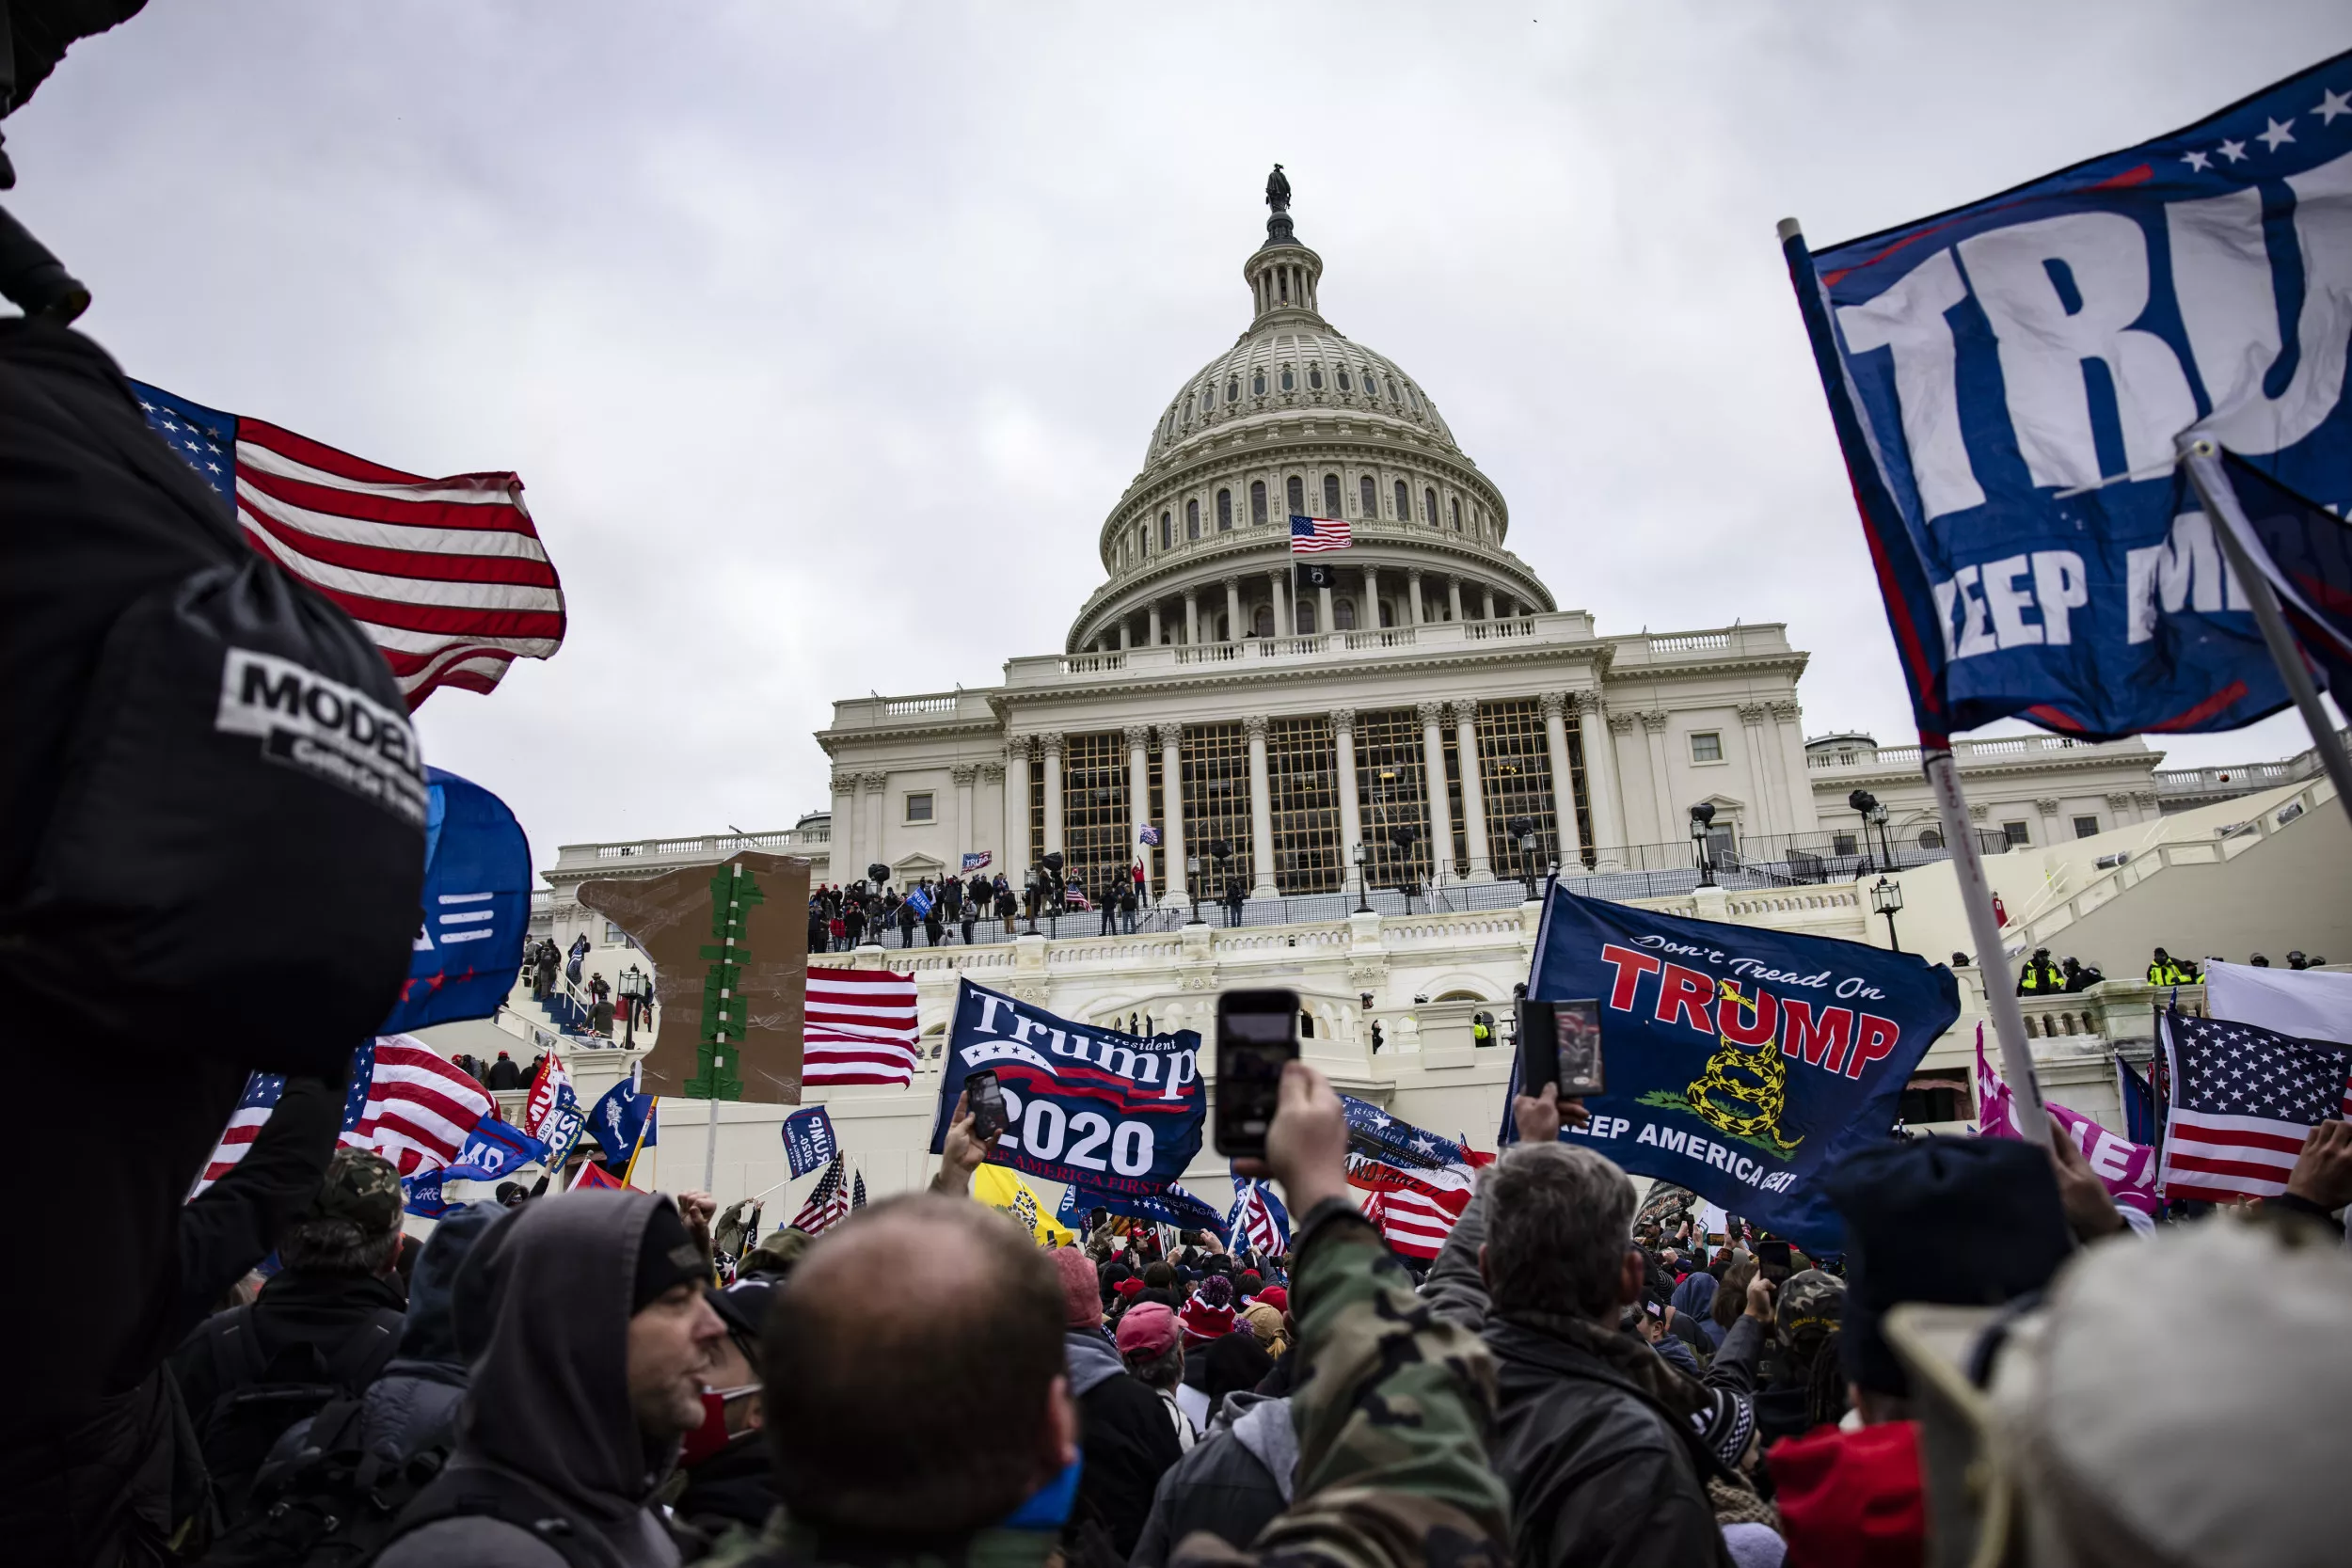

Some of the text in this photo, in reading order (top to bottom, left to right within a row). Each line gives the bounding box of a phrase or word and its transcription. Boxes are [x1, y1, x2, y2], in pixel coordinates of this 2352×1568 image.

[914, 891, 930, 911] RUMP
[1629, 934, 1886, 1001] Don't Tread On
[969, 988, 1197, 1101] Trump
[1600, 942, 1900, 1081] TRUMP
[1014, 1153, 1103, 1188] AMERICA
[1106, 1176, 1164, 1196] FIRST
[1560, 1114, 1630, 1139] EEP
[1636, 1123, 1765, 1187] AMERICA
